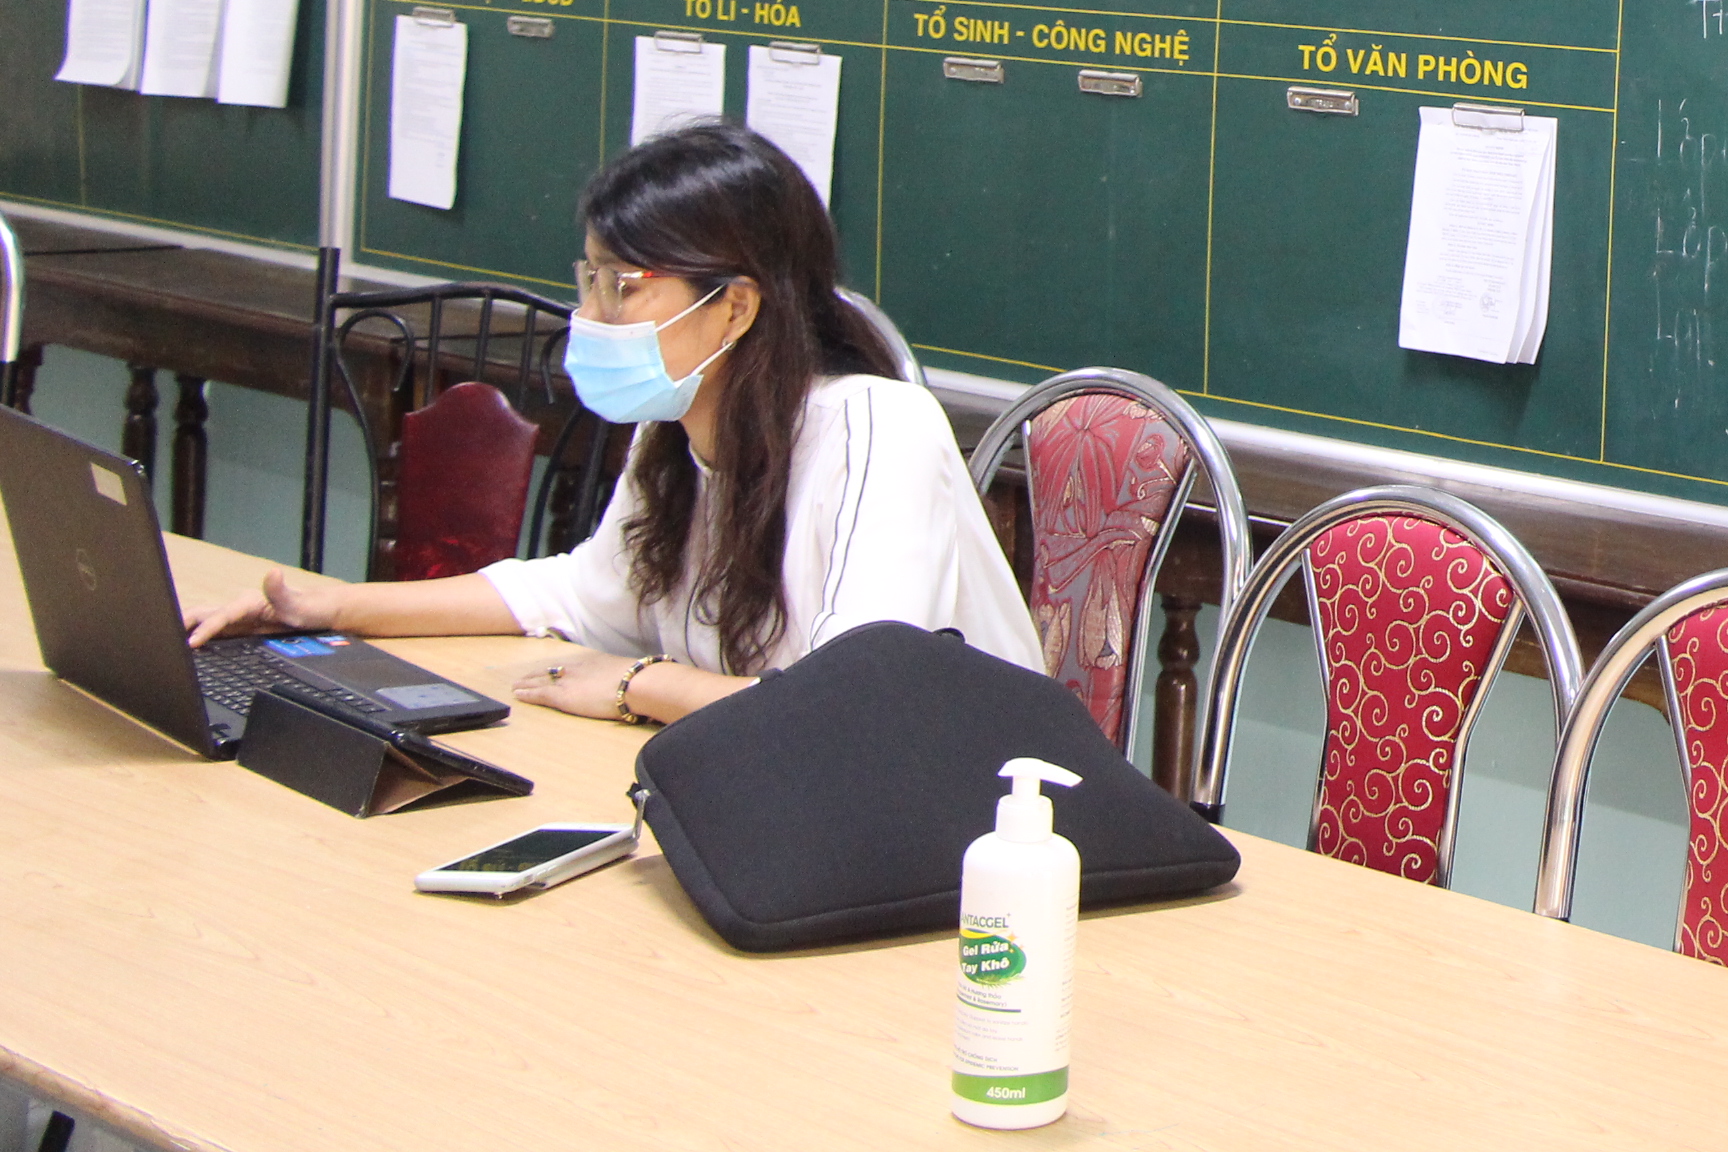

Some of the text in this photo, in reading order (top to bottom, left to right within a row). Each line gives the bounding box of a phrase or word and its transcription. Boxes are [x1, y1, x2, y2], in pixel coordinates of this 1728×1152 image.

[914, 5, 946, 40] TỔ
[953, 17, 1009, 45] SINH
[1032, 18, 1106, 54] CÔNG
[1115, 29, 1190, 66] NGHỆ
[1298, 32, 1530, 90] TỔ VĂN PHÒNG
[963, 941, 1009, 956] Gel Rửa
[962, 957, 1010, 975] Tay Khô
[986, 1086, 1026, 1099] 450ml
